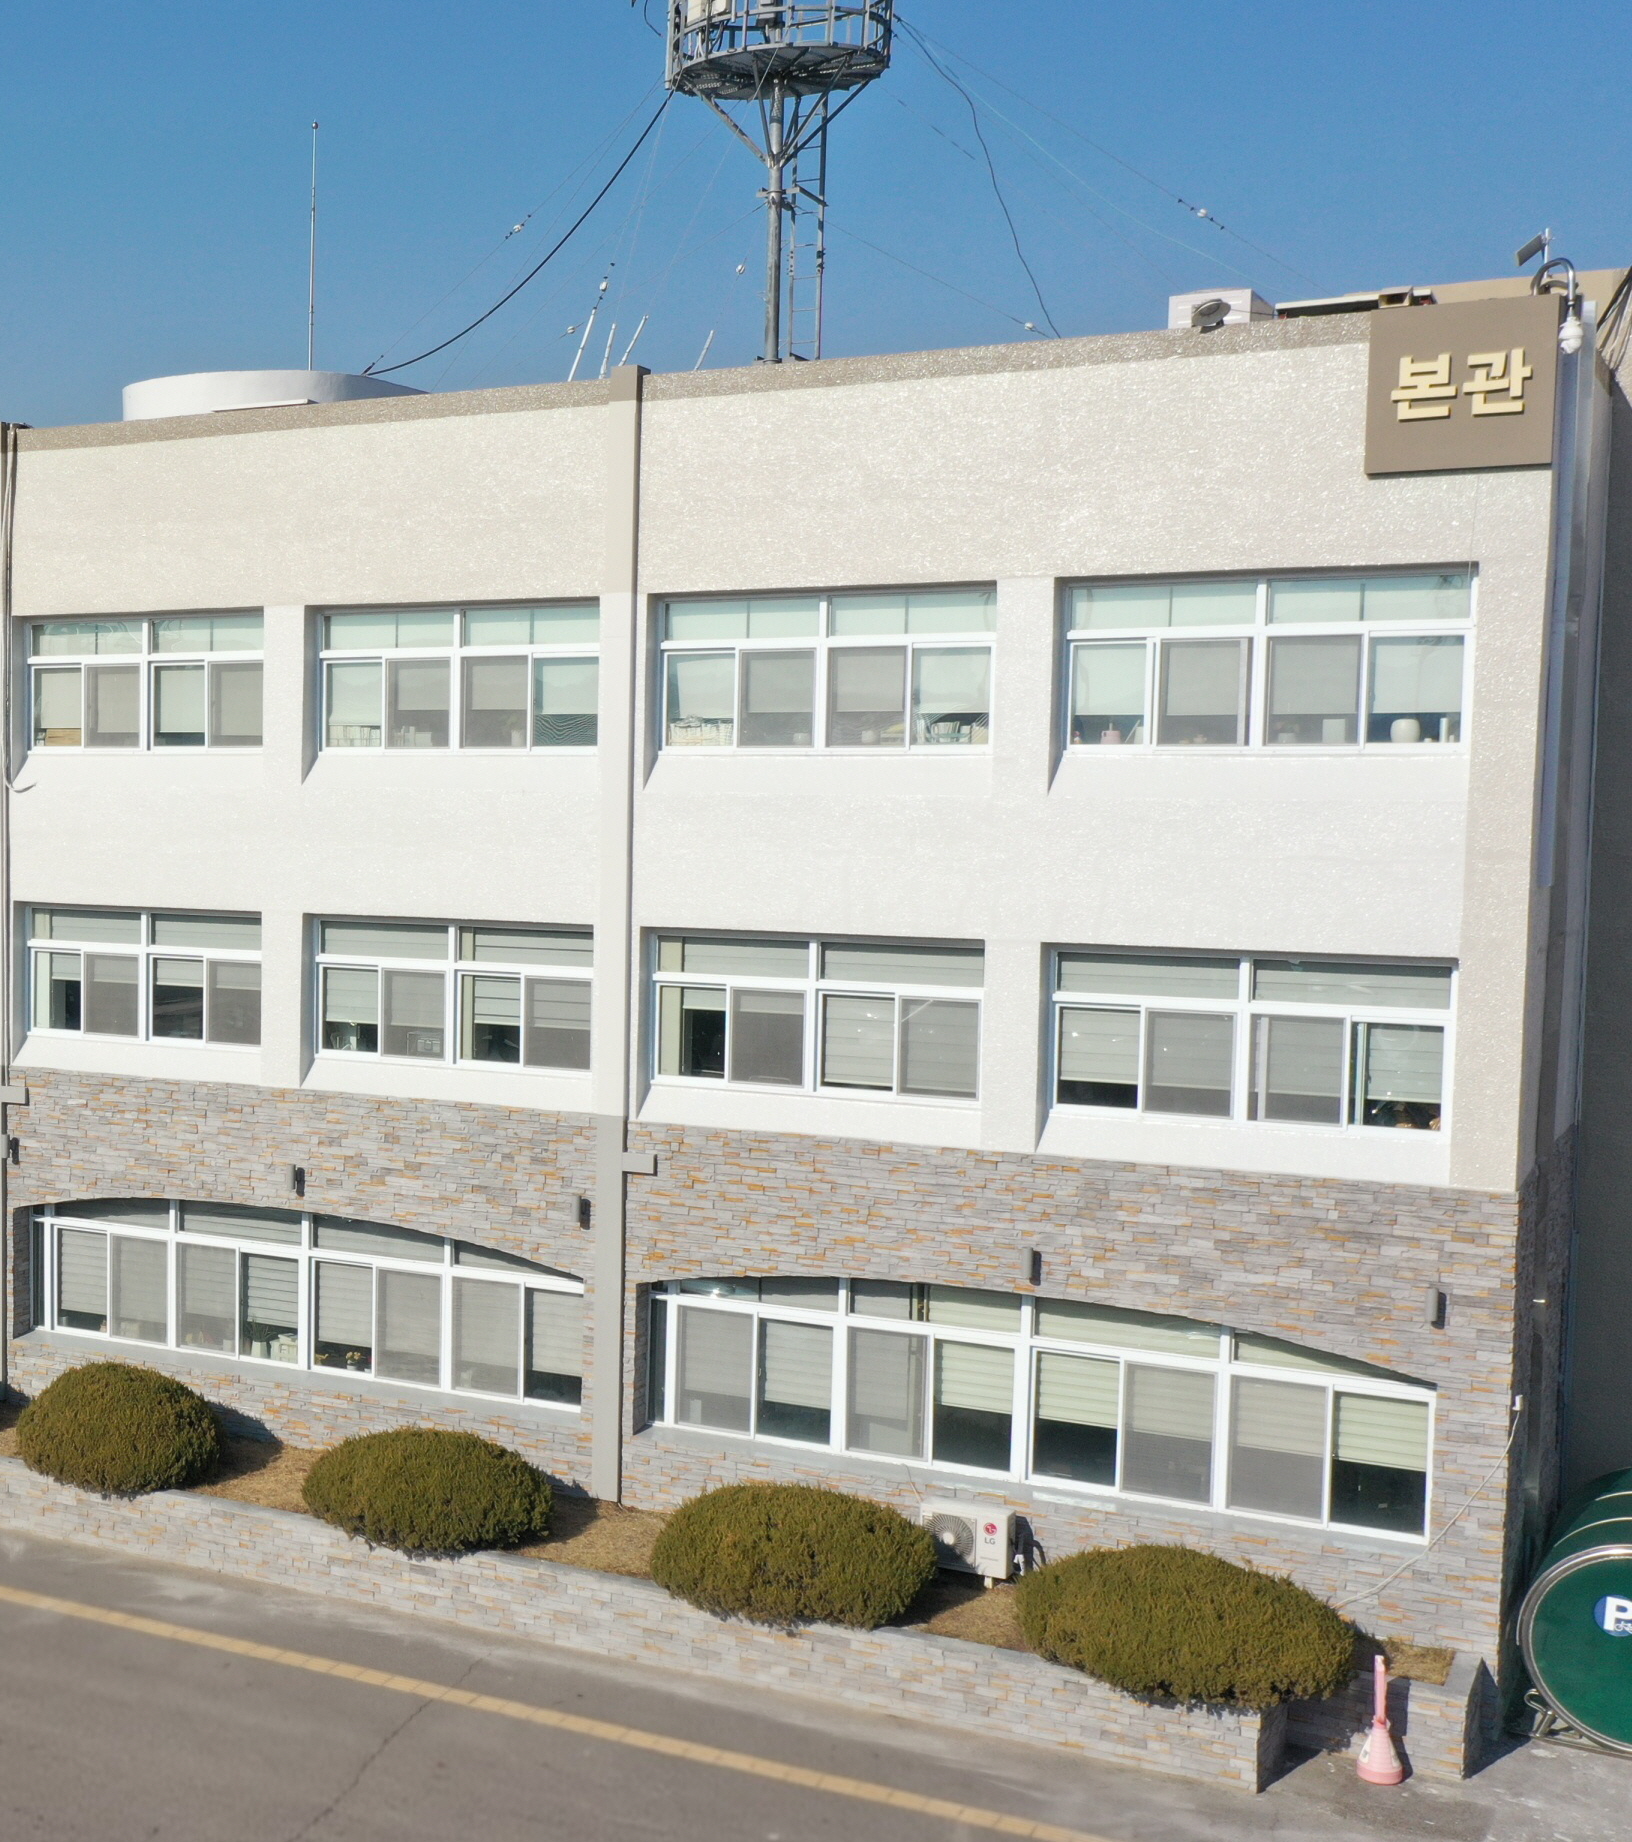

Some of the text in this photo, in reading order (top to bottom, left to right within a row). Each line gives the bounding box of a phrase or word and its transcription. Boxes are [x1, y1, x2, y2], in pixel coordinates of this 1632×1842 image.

[1390, 346, 1533, 422] 본관
[984, 1537, 996, 1545] LG
[1603, 1596, 1632, 1631] P
